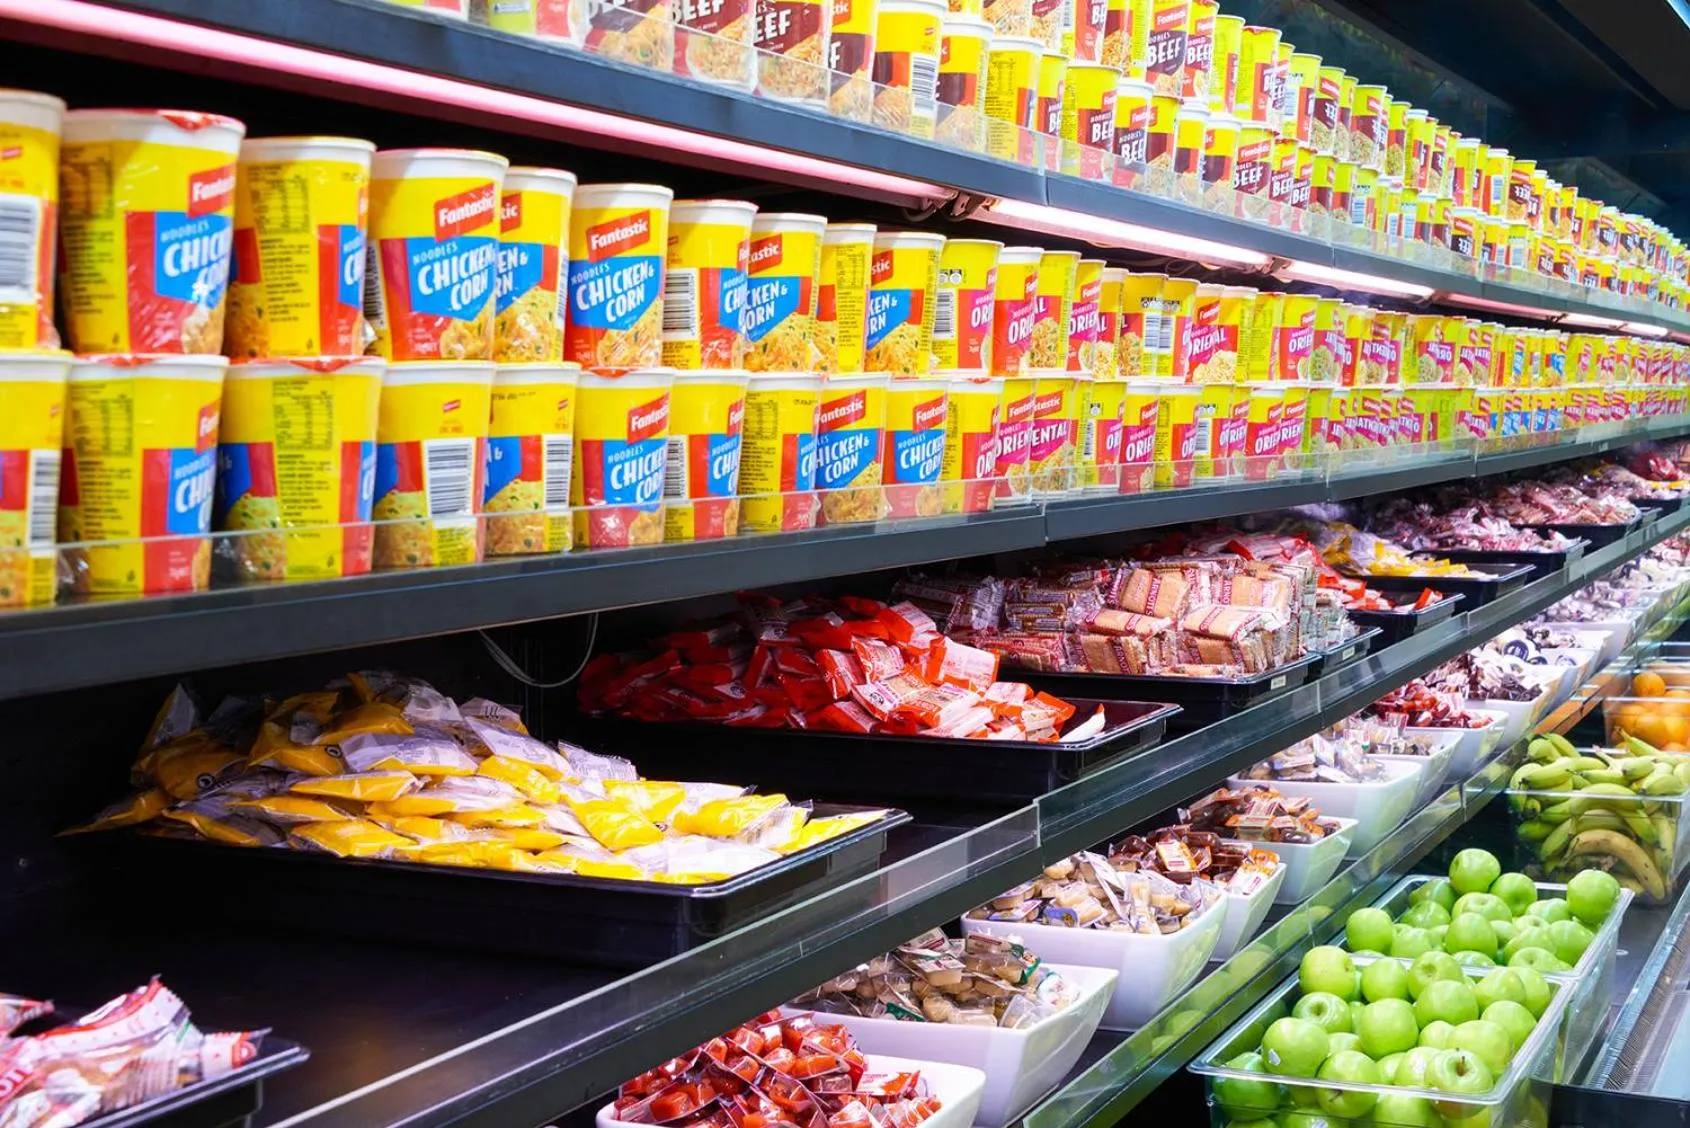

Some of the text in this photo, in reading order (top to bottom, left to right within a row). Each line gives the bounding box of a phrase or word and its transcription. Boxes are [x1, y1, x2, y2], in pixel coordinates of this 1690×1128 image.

[590, 217, 649, 251] Fantastic
[451, 267, 490, 312] CORN
[576, 260, 649, 311] CHICKEN
[605, 283, 645, 323] CORN
[824, 451, 859, 484] CORN
